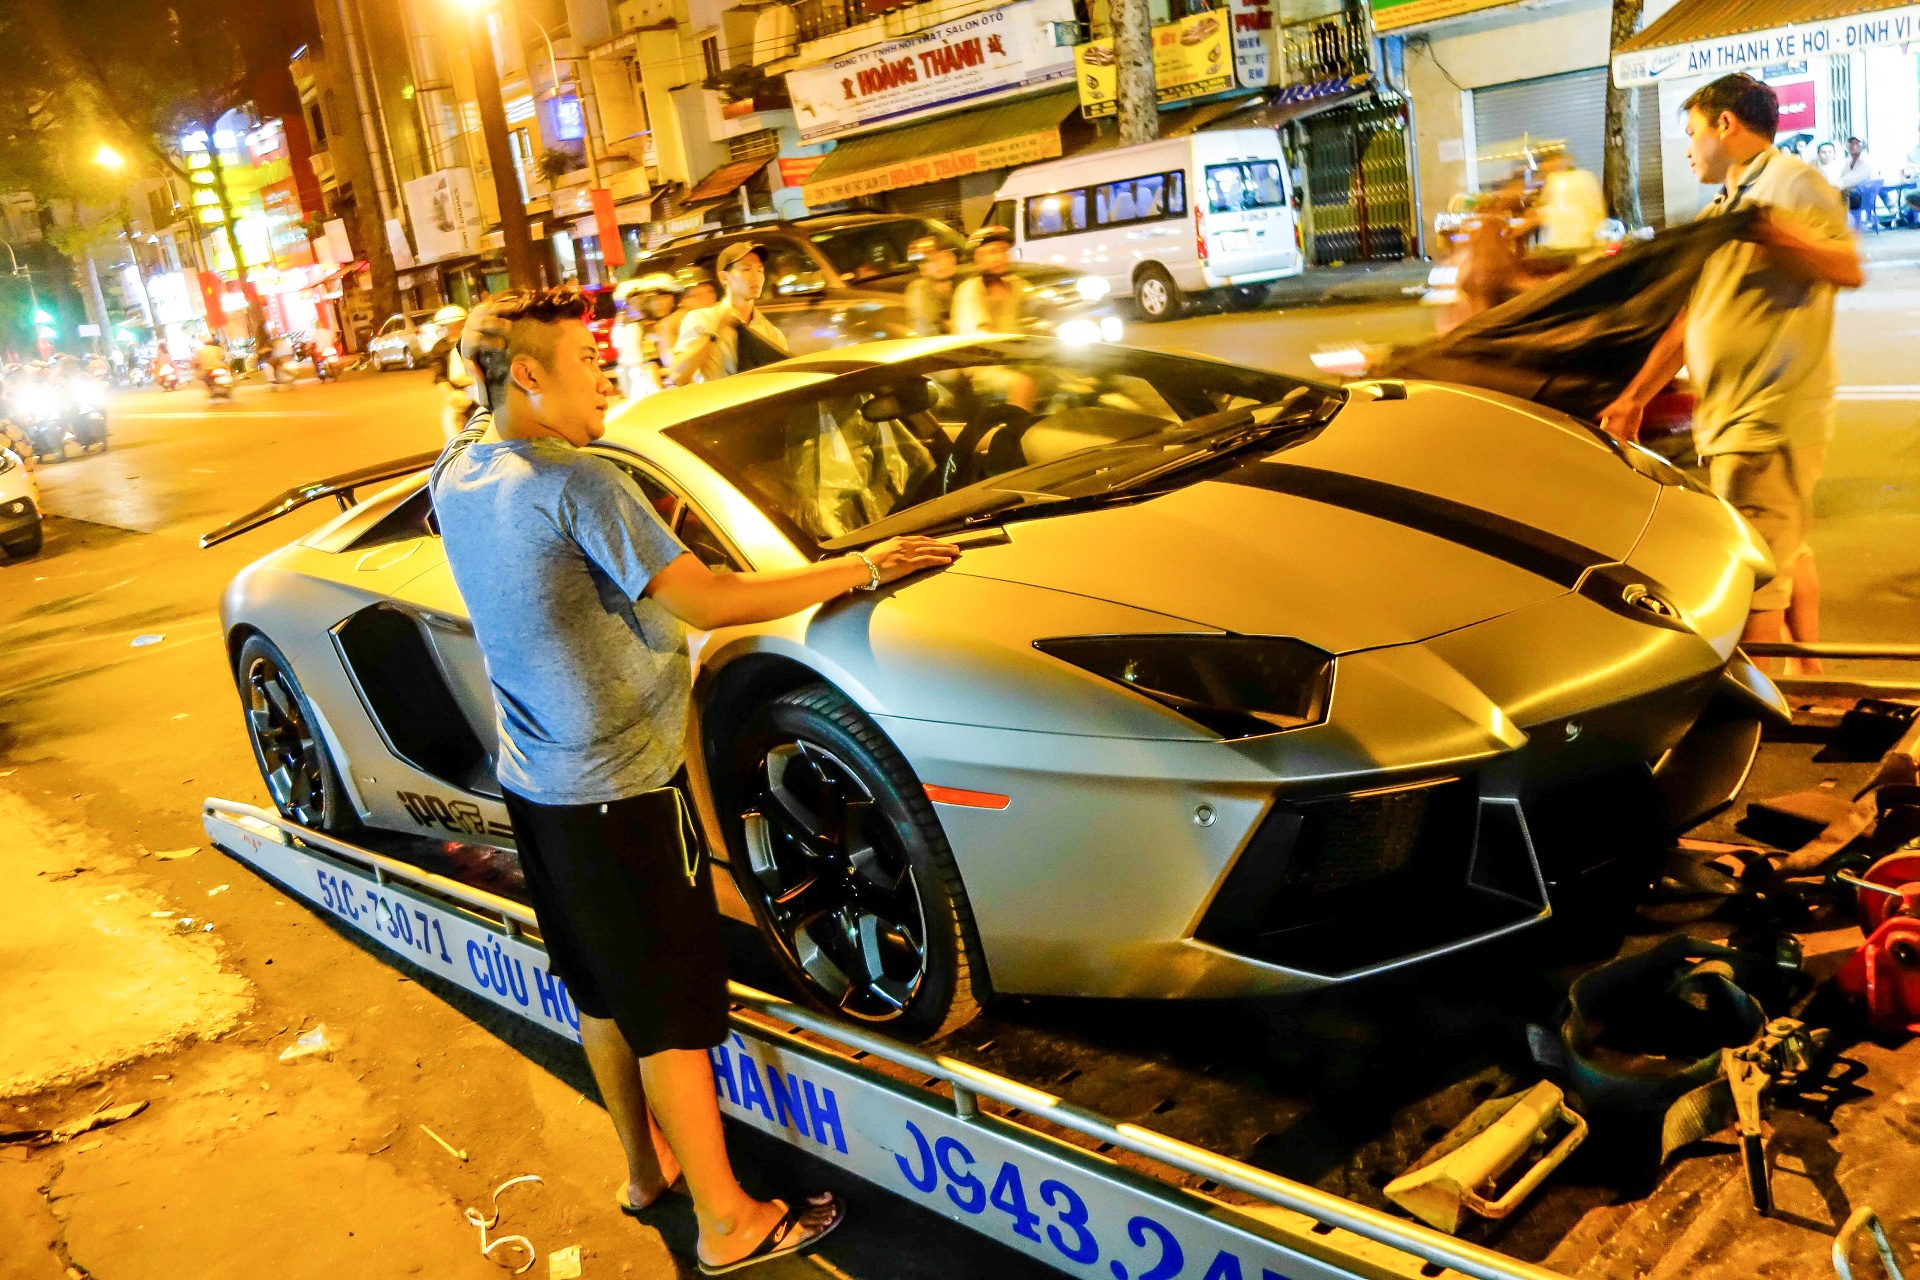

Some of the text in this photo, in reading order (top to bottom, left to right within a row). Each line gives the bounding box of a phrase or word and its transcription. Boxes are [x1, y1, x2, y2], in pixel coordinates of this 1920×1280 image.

[946, 21, 980, 37] SALON
[1717, 39, 1770, 64] THANH
[1776, 36, 1796, 57] XE
[856, 58, 919, 97] HOÀNG
[917, 37, 986, 79] THÀNH
[467, 934, 528, 1007] CỨU
[707, 1033, 848, 1155] HÀNH
[895, 1120, 1294, 1280] 0943.2
